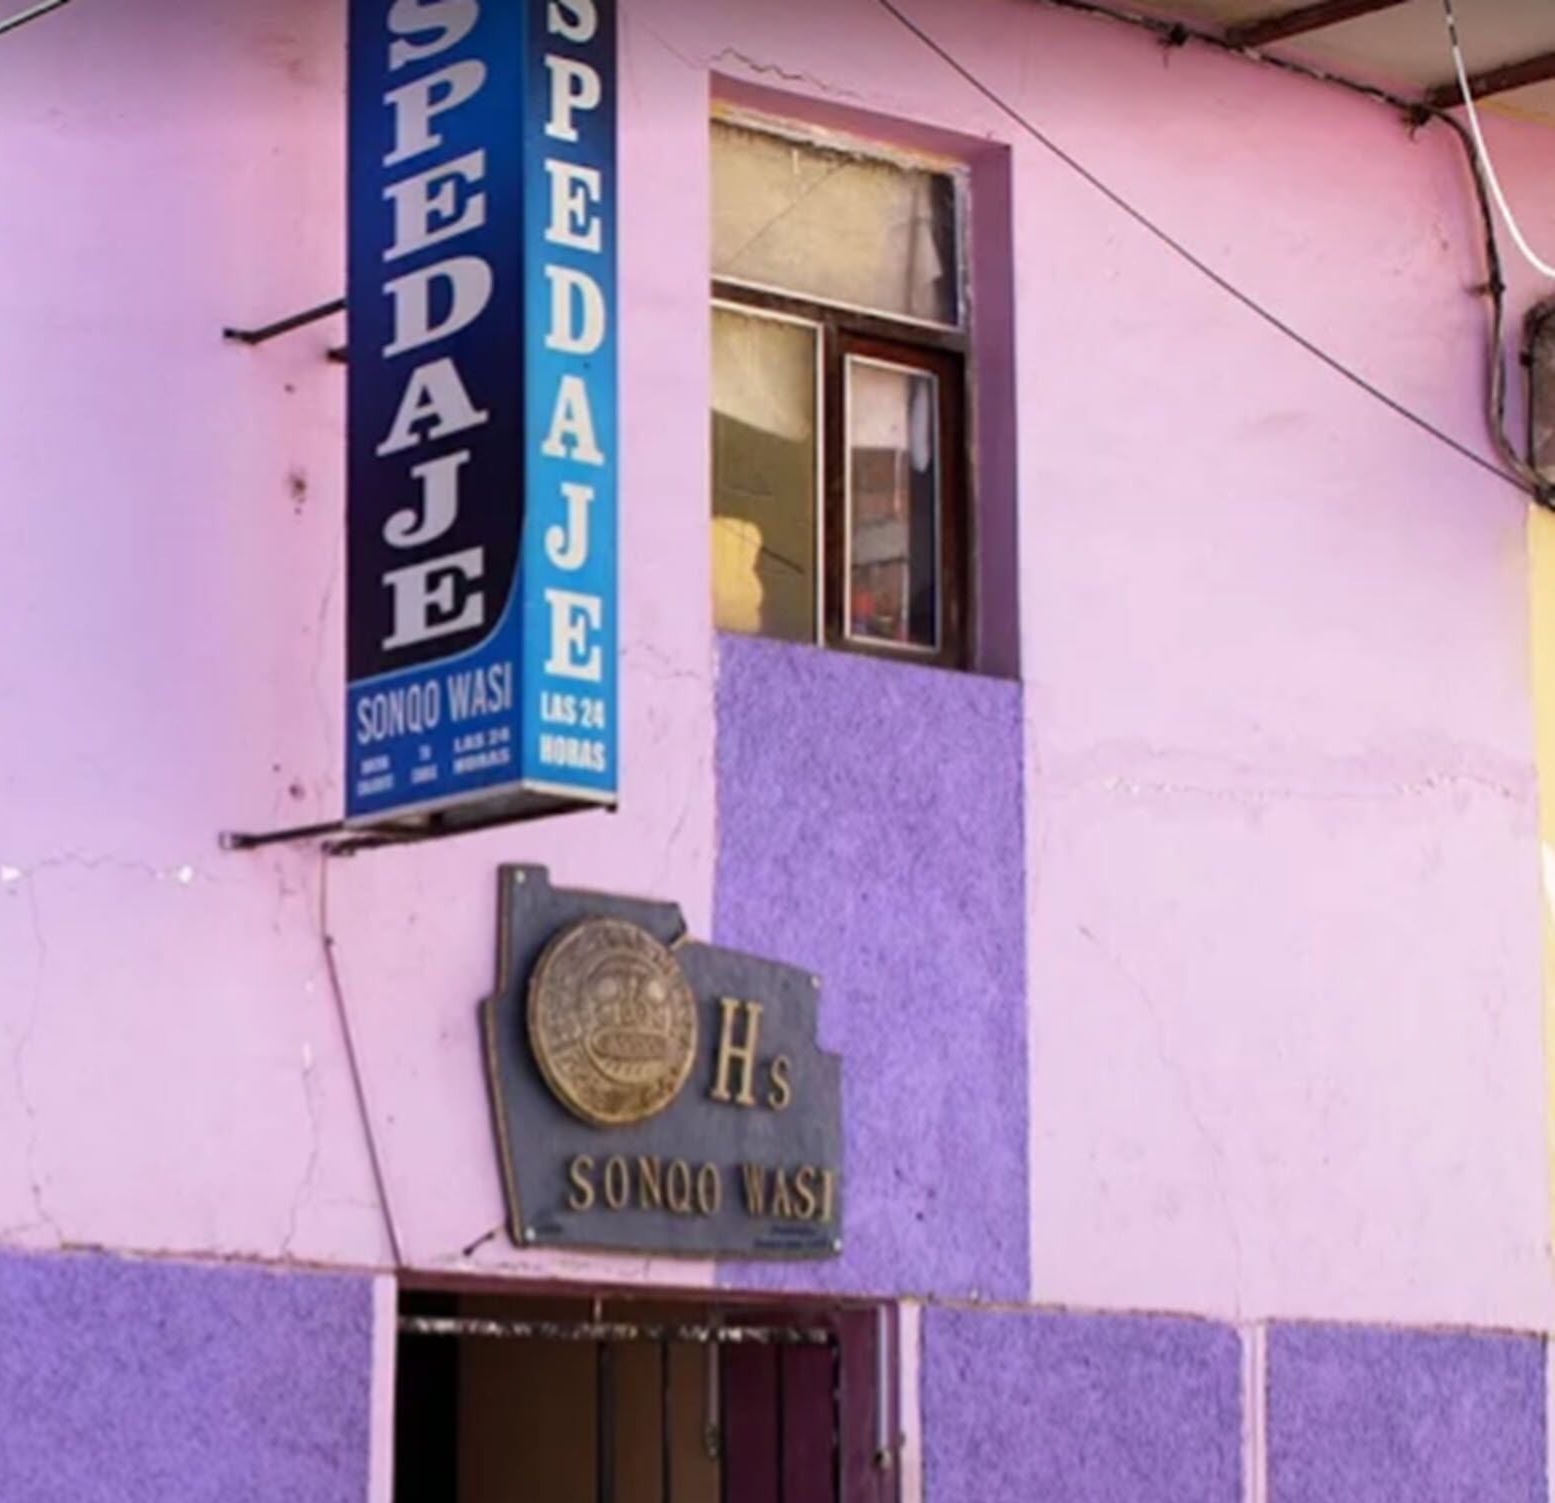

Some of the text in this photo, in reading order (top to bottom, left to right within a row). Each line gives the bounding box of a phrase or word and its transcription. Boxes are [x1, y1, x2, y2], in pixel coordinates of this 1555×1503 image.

[376, 0, 494, 651] SPEDAJE
[357, 662, 512, 744] SONQO WASI
[540, 692, 605, 729] LAS 24
[540, 735, 605, 772] HORAS
[568, 1155, 835, 1221] SONQO WASI
